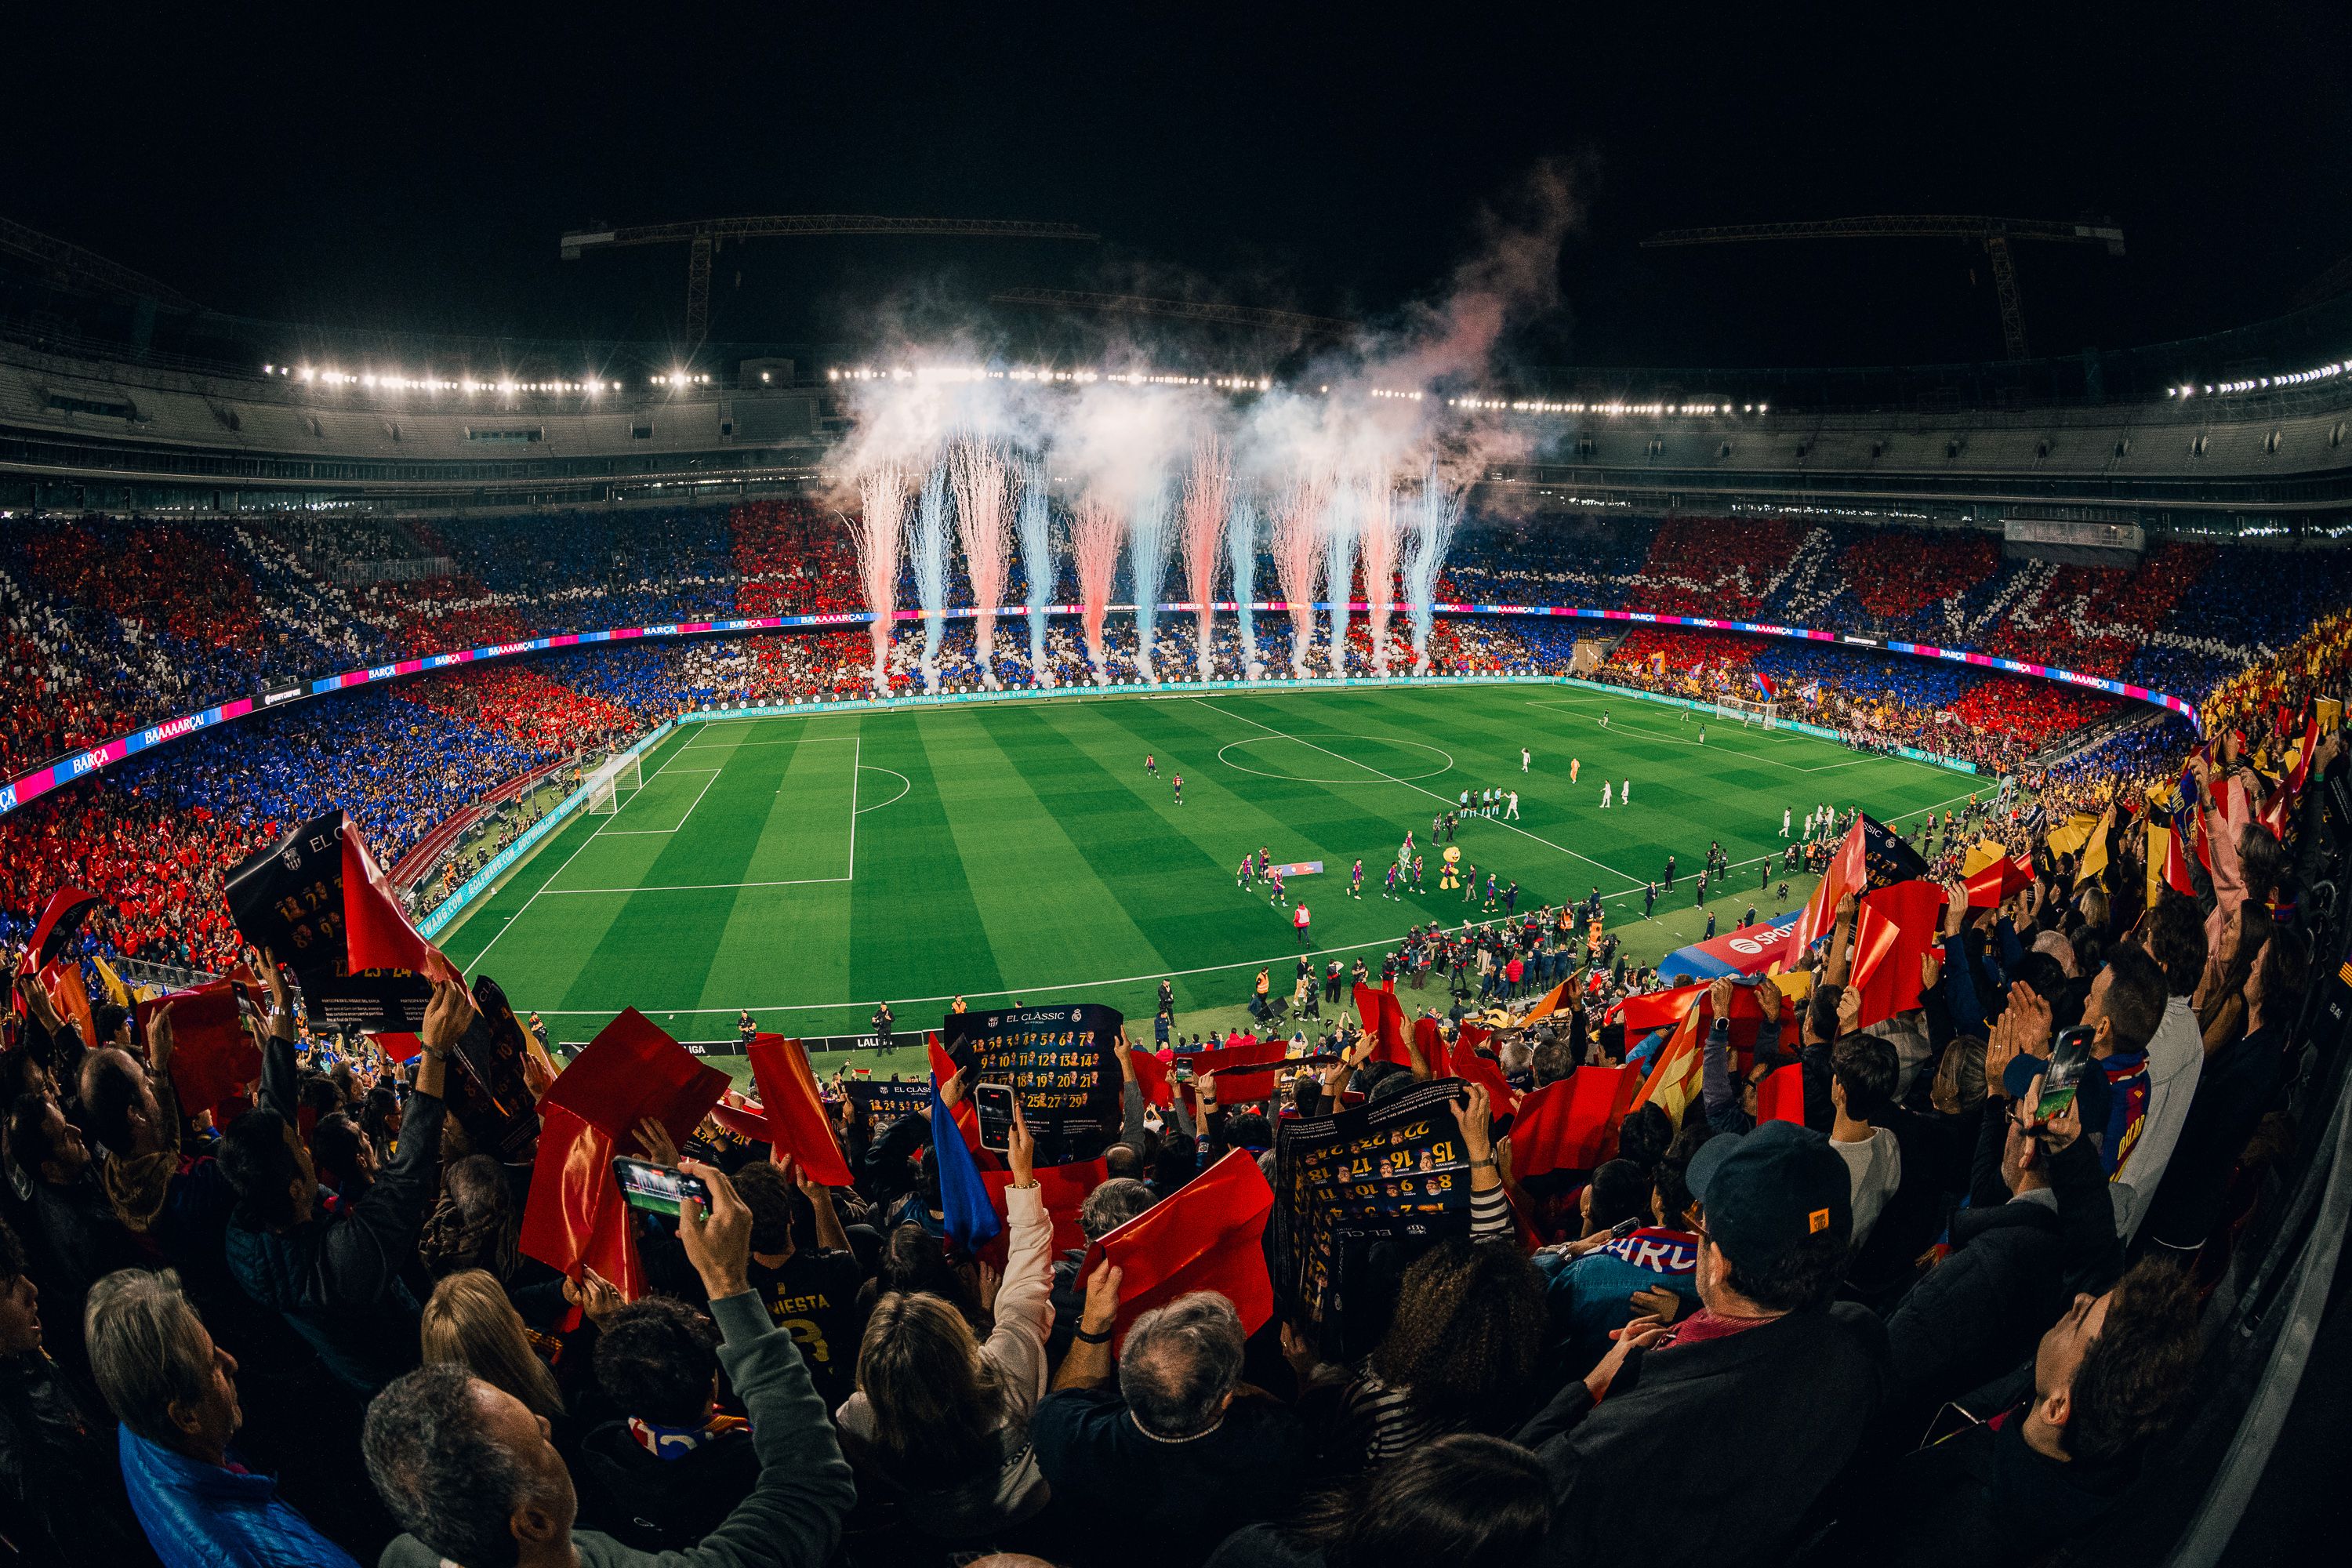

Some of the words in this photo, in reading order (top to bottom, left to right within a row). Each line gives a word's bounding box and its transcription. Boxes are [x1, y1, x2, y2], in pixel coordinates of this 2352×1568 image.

[1630, 612, 1656, 622] BARÇA
[1693, 618, 1718, 627] BARÇA
[729, 619, 763, 628] BARÇA
[644, 626, 677, 635] BARÇA
[434, 653, 461, 665] BARÇA
[1940, 649, 1966, 661] BARÇA
[2005, 660, 2031, 672] BARÇA
[368, 666, 395, 679] BARÇA
[1036, 687, 1097, 697] GOLFWANG.COM
[1103, 684, 1163, 693] GOLFWANG.COM
[894, 695, 958, 705] GOLFWANG.COM
[967, 691, 1029, 701] GOLFWANG.COM
[681, 710, 742, 721] GOLFWANG.COM
[751, 705, 816, 715] GOLFWANG.COM
[73, 749, 109, 774] BARÇA
[517, 814, 556, 851] GOLFWANG.COM
[310, 834, 332, 854] EL
[468, 848, 515, 895] GOLFWANG.COM
[1006, 1014, 1019, 1023] EL
[1021, 1011, 1065, 1021] CLÀSSIC
[1040, 1035, 1047, 1046] 5
[1058, 1035, 1066, 1047] 6
[1079, 1034, 1087, 1047] 7
[981, 1057, 988, 1069] 9
[999, 1056, 1010, 1067] 10
[1019, 1054, 1028, 1066] 11
[1037, 1054, 1050, 1067] 12
[1059, 1055, 1071, 1067] 13
[1080, 1055, 1092, 1067] 14
[1017, 1076, 1027, 1087] 18
[1036, 1076, 1047, 1087] 19
[1057, 1076, 1070, 1087] 20
[1080, 1076, 1091, 1087] 21
[870, 1102, 875, 1111] 1
[884, 1102, 891, 1111] 2
[898, 1102, 905, 1111] 3
[913, 1102, 920, 1111] 4
[1027, 1095, 1040, 1108] 25
[1047, 1096, 1061, 1109] 27
[1069, 1096, 1082, 1108] 29
[1404, 1120, 1429, 1138] 22
[731, 1132, 745, 1145] 21
[1432, 1142, 1456, 1163] 15
[1390, 1149, 1414, 1169] 16
[1352, 1157, 1373, 1174] 17
[1308, 1167, 1331, 1181] 18
[1400, 1179, 1414, 1192] 9
[1438, 1174, 1452, 1189] 8
[1318, 1188, 1337, 1200] 11
[1355, 1184, 1378, 1196] 10
